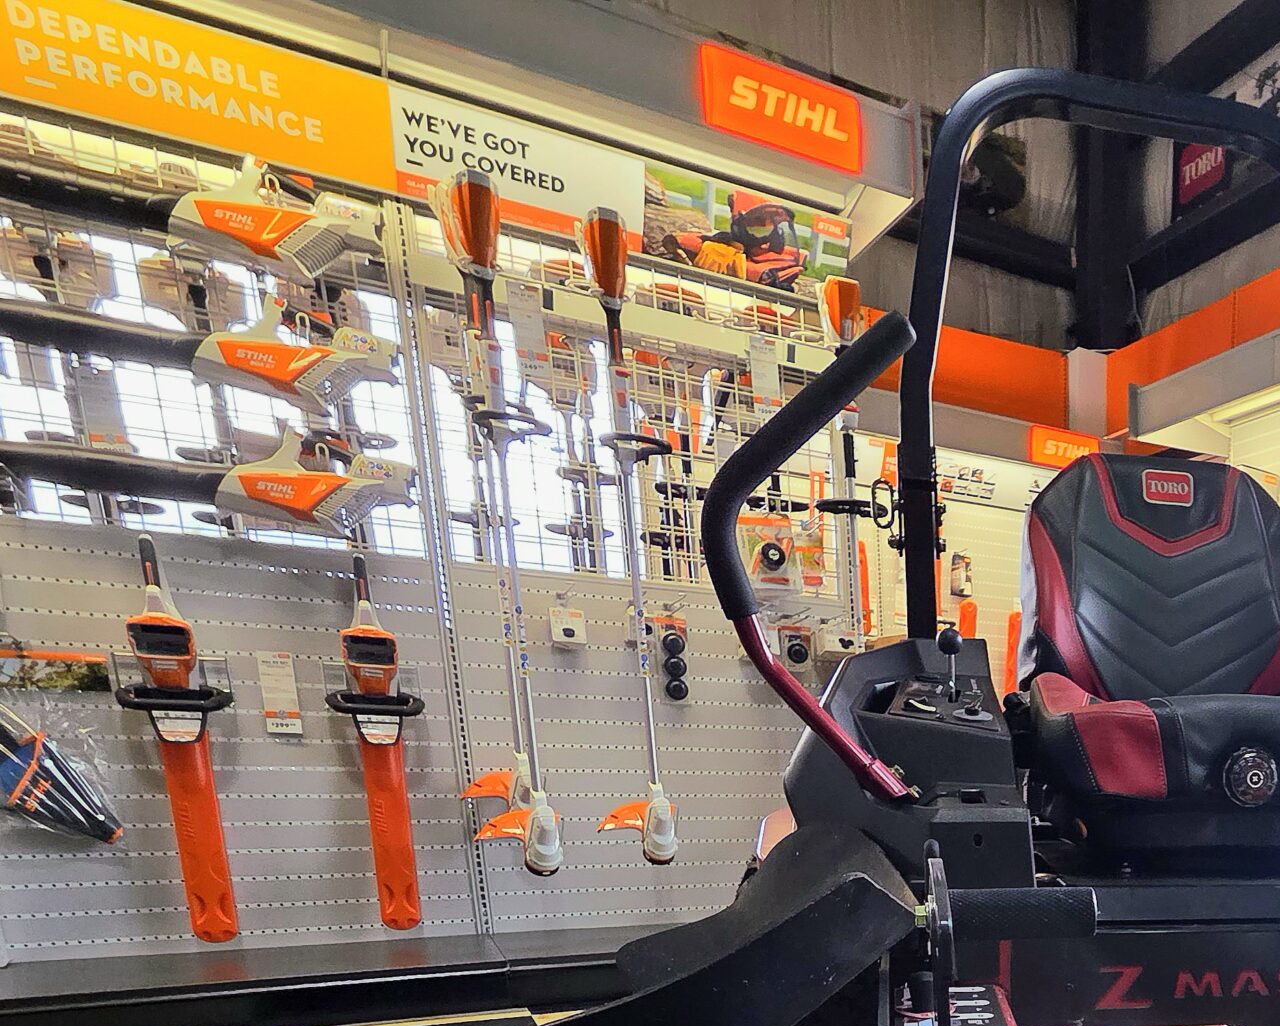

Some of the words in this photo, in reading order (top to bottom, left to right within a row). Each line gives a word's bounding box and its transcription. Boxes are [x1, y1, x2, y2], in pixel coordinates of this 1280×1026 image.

[5, 0, 281, 99] DEPENDABLE
[15, 37, 325, 143] PERFORMANCE
[729, 75, 848, 142] STIHL
[402, 107, 477, 145] WE'VE
[483, 132, 530, 159] GOT
[404, 134, 454, 163] YOU
[461, 152, 565, 193] COVERED
[1183, 146, 1222, 186] TORO
[213, 208, 256, 226] STIHL
[235, 348, 277, 364] STIHL
[255, 480, 296, 495] STIHL
[1148, 479, 1190, 495] TORO
[1094, 965, 1153, 1010] Z
